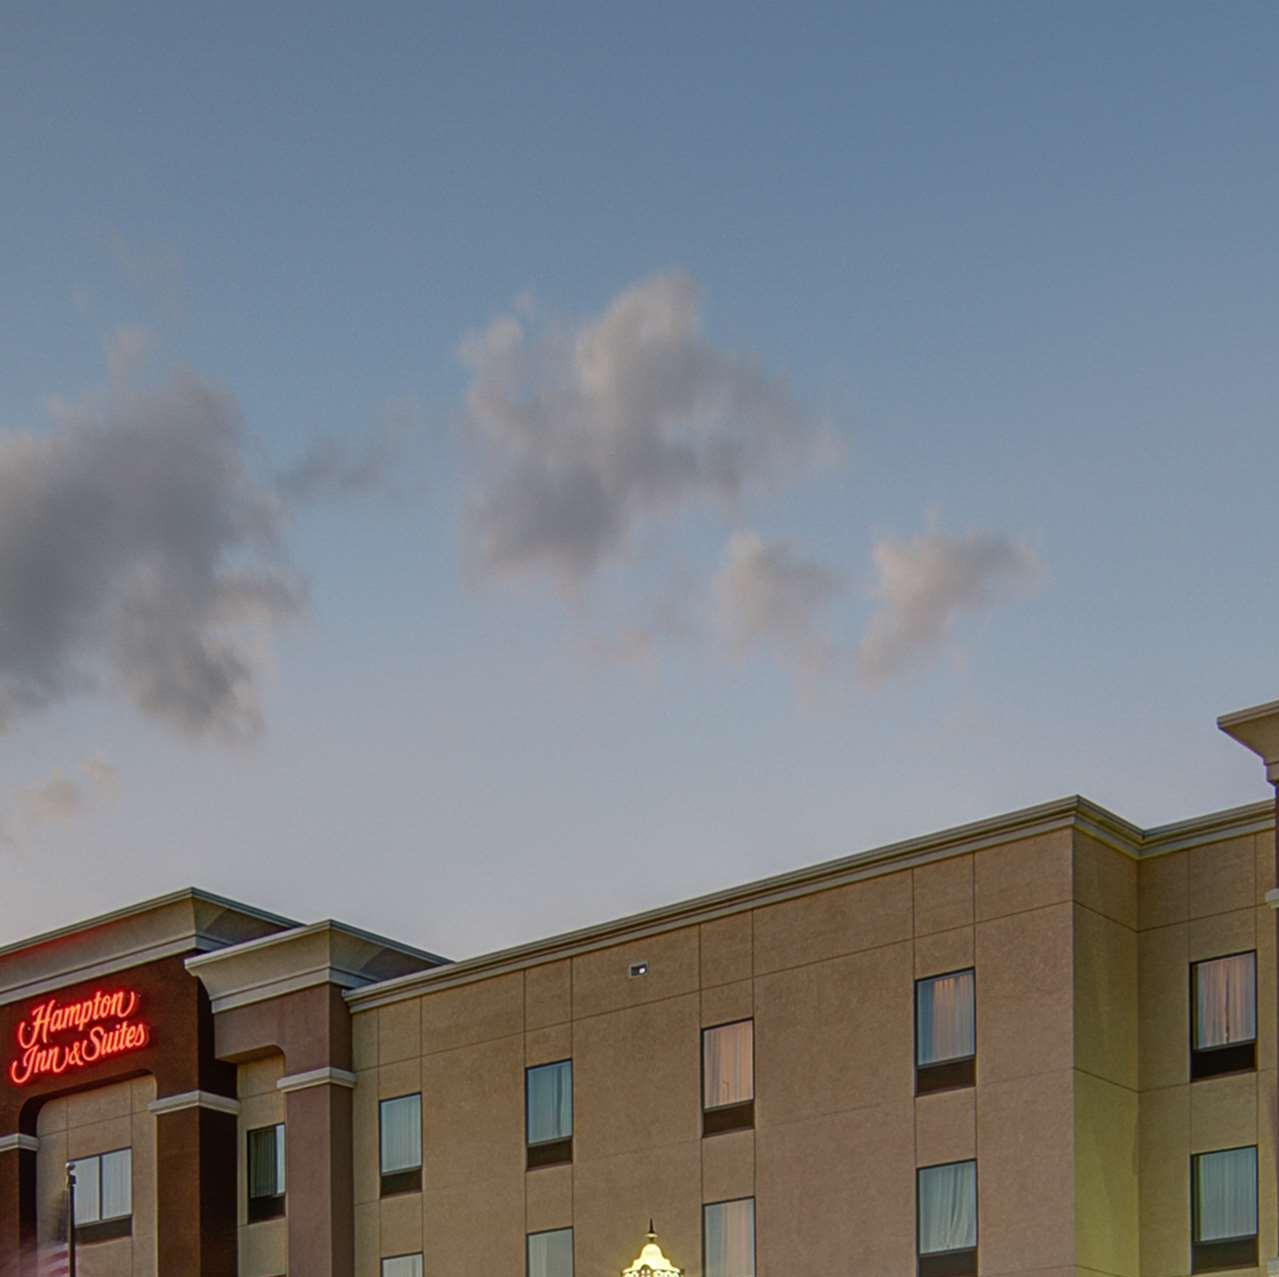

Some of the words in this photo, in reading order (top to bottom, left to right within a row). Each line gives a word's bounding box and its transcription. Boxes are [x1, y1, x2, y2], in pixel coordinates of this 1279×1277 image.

[18, 991, 135, 1049] Hampton
[11, 1044, 70, 1084] Inn
[68, 1041, 84, 1066] &
[81, 1021, 145, 1061] Suites
